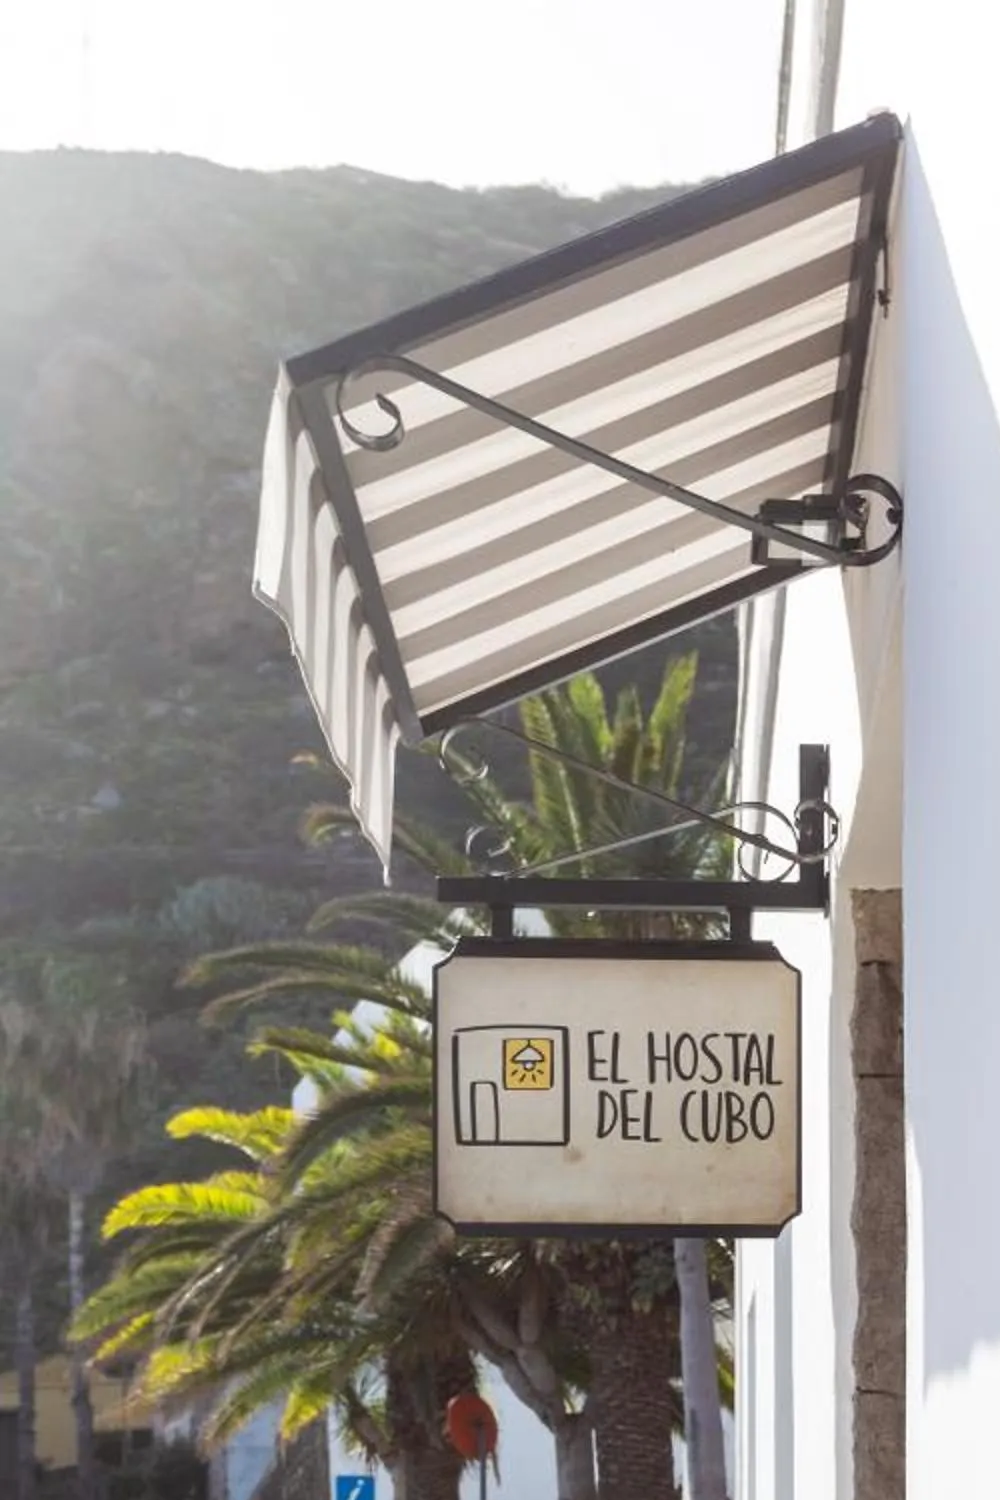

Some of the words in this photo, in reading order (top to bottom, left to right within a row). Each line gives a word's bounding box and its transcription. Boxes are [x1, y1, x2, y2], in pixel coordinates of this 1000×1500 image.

[587, 1030, 628, 1084] EL
[648, 1031, 783, 1086] HOSTAL
[596, 1089, 662, 1143] DEL
[680, 1090, 775, 1144] CUBO
